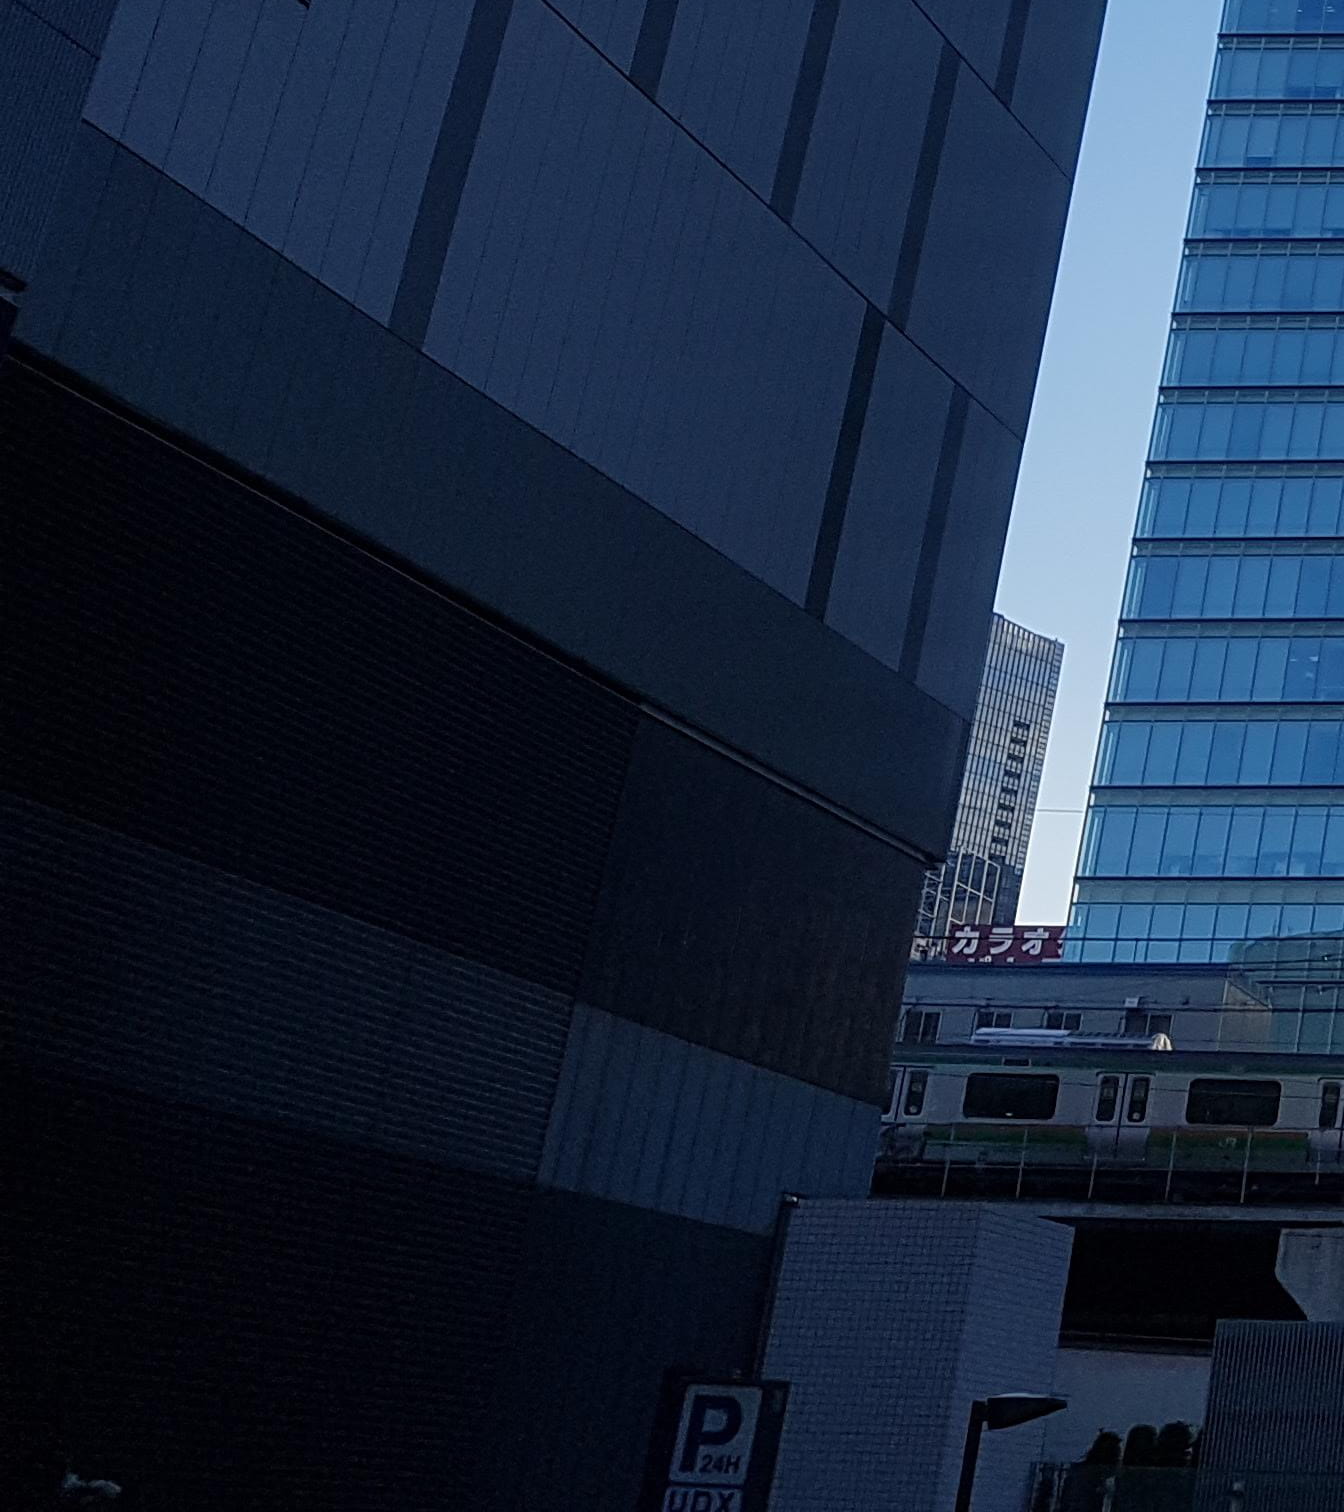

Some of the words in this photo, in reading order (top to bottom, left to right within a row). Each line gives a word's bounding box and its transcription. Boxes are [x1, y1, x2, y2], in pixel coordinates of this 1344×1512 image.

[951, 926, 1066, 956] カラオ
[678, 1395, 743, 1474] P
[699, 1454, 741, 1474] 24H
